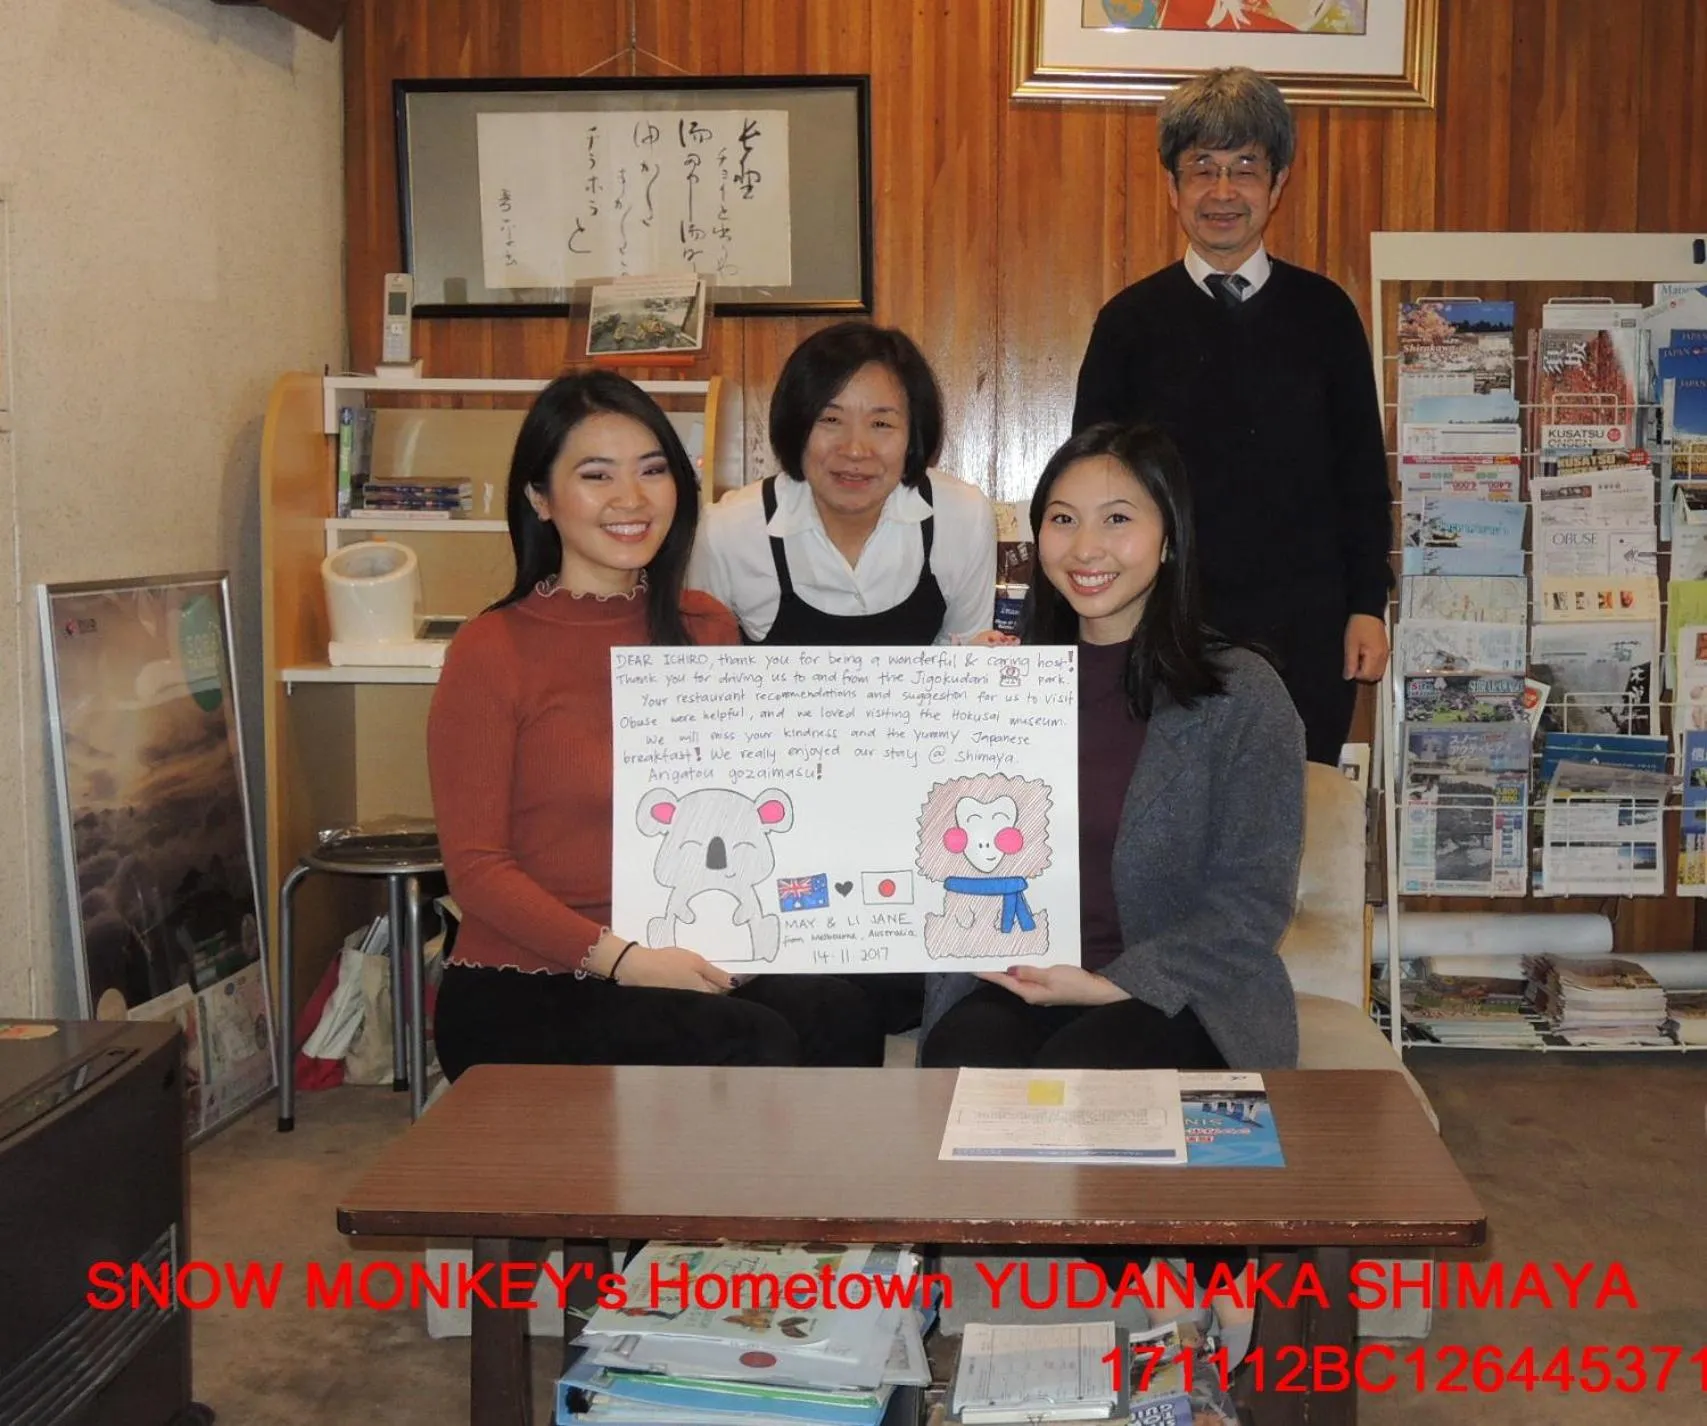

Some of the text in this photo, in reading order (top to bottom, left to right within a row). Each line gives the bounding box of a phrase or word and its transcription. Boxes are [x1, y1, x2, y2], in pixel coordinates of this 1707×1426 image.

[1548, 429, 1604, 439] KUSATSU
[1552, 532, 1597, 546] OBUSE
[616, 654, 652, 669] DEAR
[717, 654, 757, 666] thank
[765, 656, 790, 670] you
[799, 651, 820, 665] for
[829, 653, 862, 668] being
[871, 656, 880, 666] a
[888, 651, 957, 668] wonderful
[965, 653, 979, 666] &
[615, 673, 657, 684] Thank
[666, 673, 686, 687] you
[694, 671, 709, 682] for
[719, 672, 763, 688] driving
[771, 674, 786, 682] us
[793, 672, 806, 682] to
[812, 672, 837, 682] and
[842, 670, 869, 684] from
[879, 672, 904, 683] the
[642, 695, 668, 708] Your
[676, 690, 745, 703] restaurant
[867, 689, 891, 699] and
[976, 691, 997, 702] for
[1005, 694, 1019, 702] us
[1027, 692, 1038, 704] to
[1045, 691, 1074, 705] visit
[620, 716, 657, 728] Obuse
[670, 714, 696, 723] were
[760, 707, 785, 719] and
[797, 709, 812, 717] we
[821, 707, 855, 719] loved
[866, 709, 910, 724] visiting
[920, 709, 941, 720] the
[680, 732, 698, 743] will
[711, 731, 735, 740] miss
[746, 732, 773, 743] your
[784, 727, 838, 738] kindness
[851, 728, 876, 738] and
[887, 729, 905, 738] the
[972, 731, 1030, 746] Japanese
[711, 750, 731, 760] We
[740, 749, 776, 764] really
[788, 745, 840, 762] enjoyed
[854, 748, 876, 757] our
[928, 745, 946, 764] @
[785, 918, 816, 929] MAY
[827, 917, 836, 928] &
[871, 912, 913, 925] JANE
[861, 947, 889, 962] 2017
